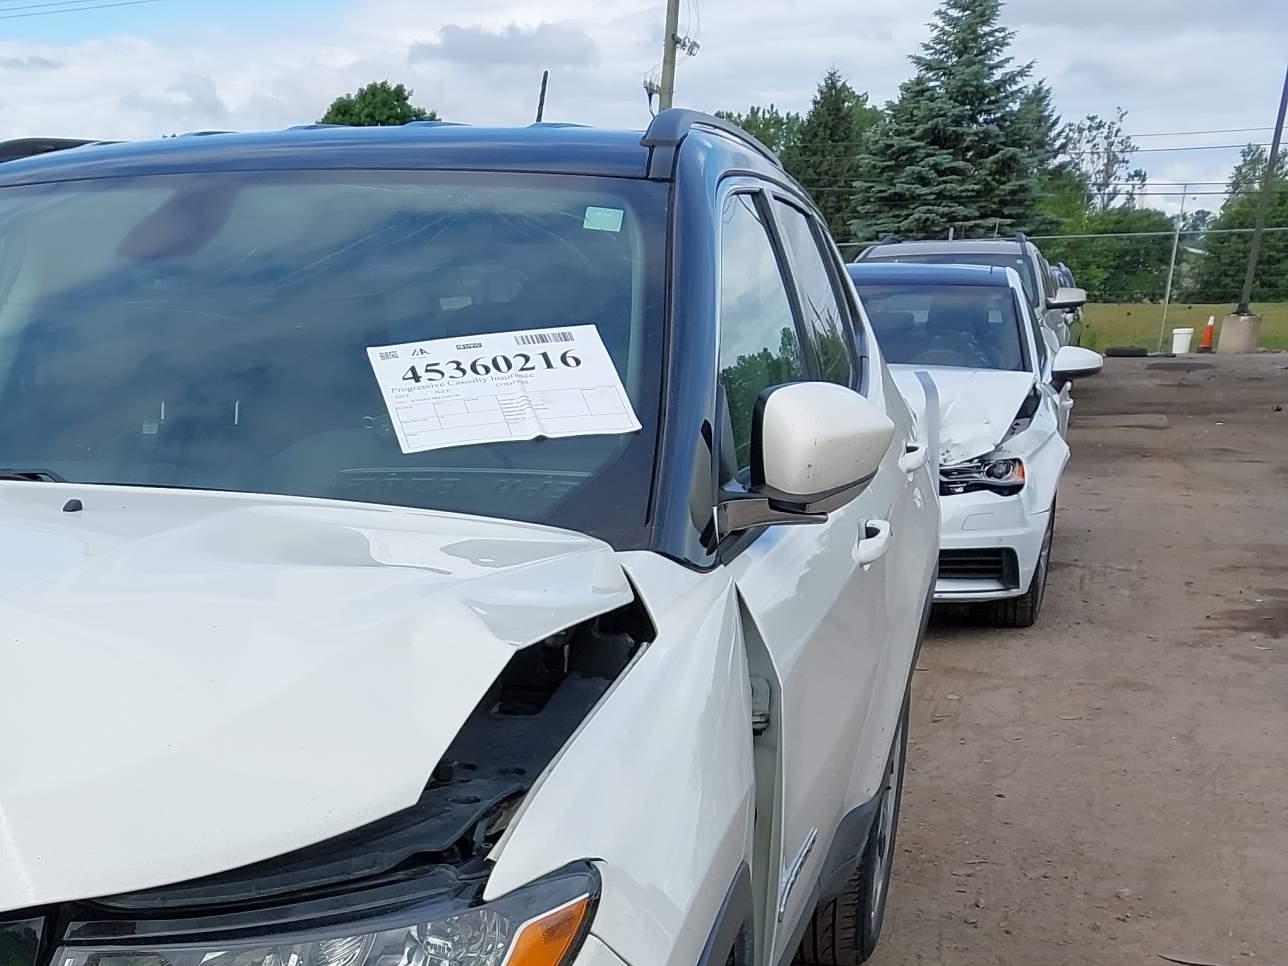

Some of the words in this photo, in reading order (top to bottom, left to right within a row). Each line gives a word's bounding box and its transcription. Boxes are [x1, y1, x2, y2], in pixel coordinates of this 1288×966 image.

[401, 348, 582, 384] 45360216
[391, 382, 445, 394] Progressive
[447, 376, 487, 387] Casualty
[490, 372, 535, 382] Insurance
